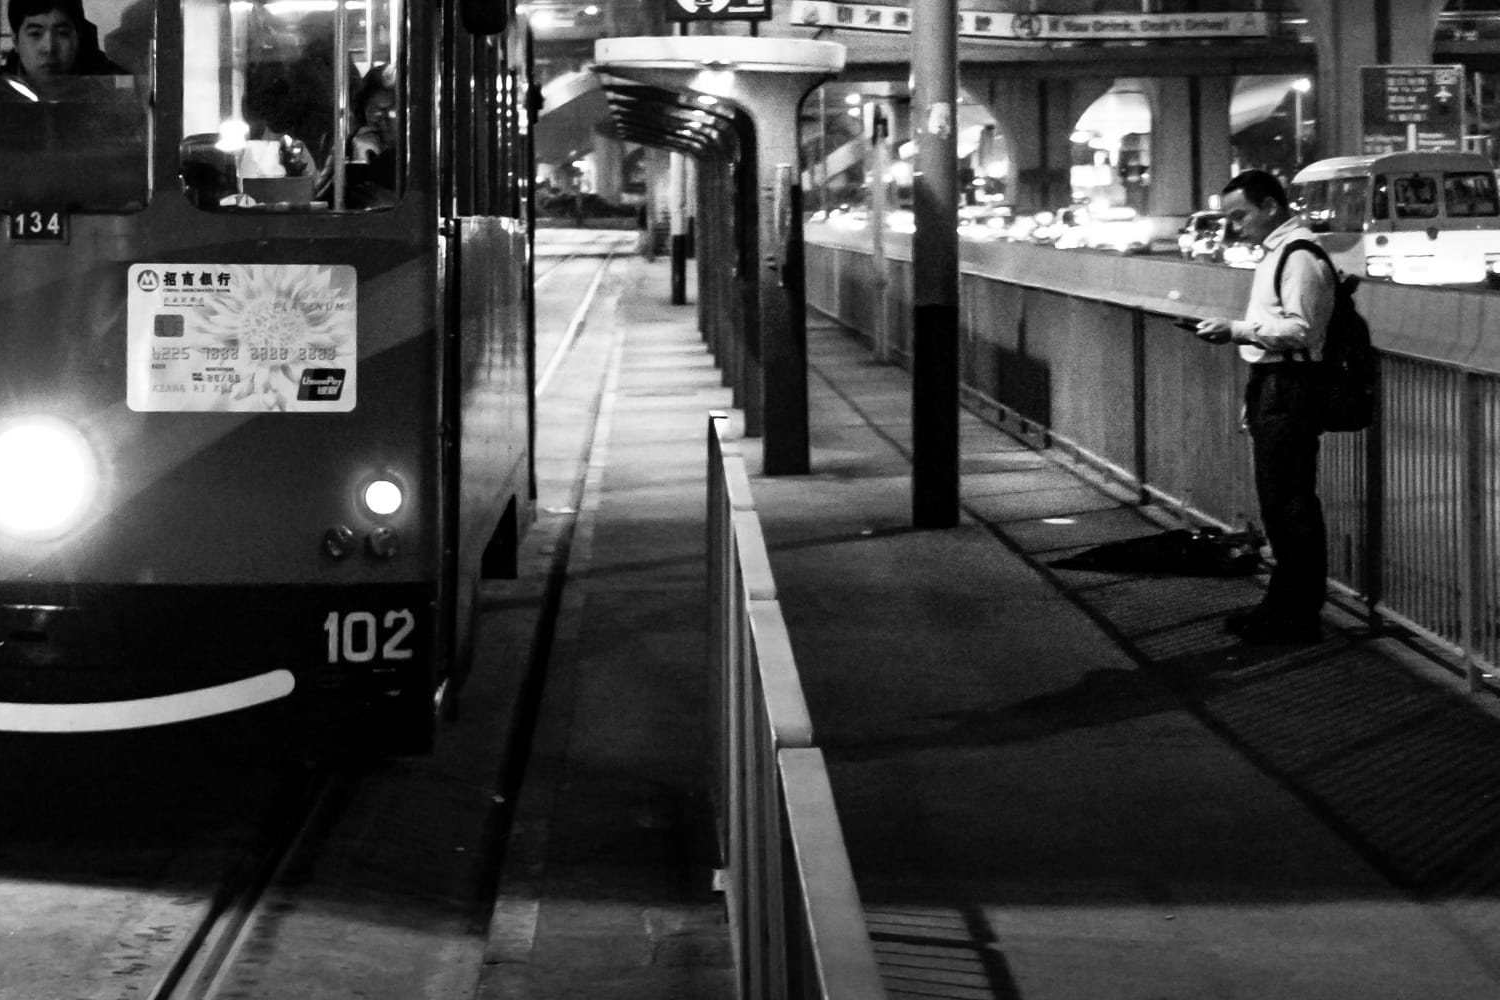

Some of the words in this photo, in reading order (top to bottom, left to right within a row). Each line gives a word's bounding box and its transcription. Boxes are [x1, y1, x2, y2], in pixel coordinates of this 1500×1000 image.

[15, 210, 60, 236] 134
[272, 302, 345, 312] PLATINUM
[152, 347, 190, 361] 6225
[323, 608, 416, 663] 102
